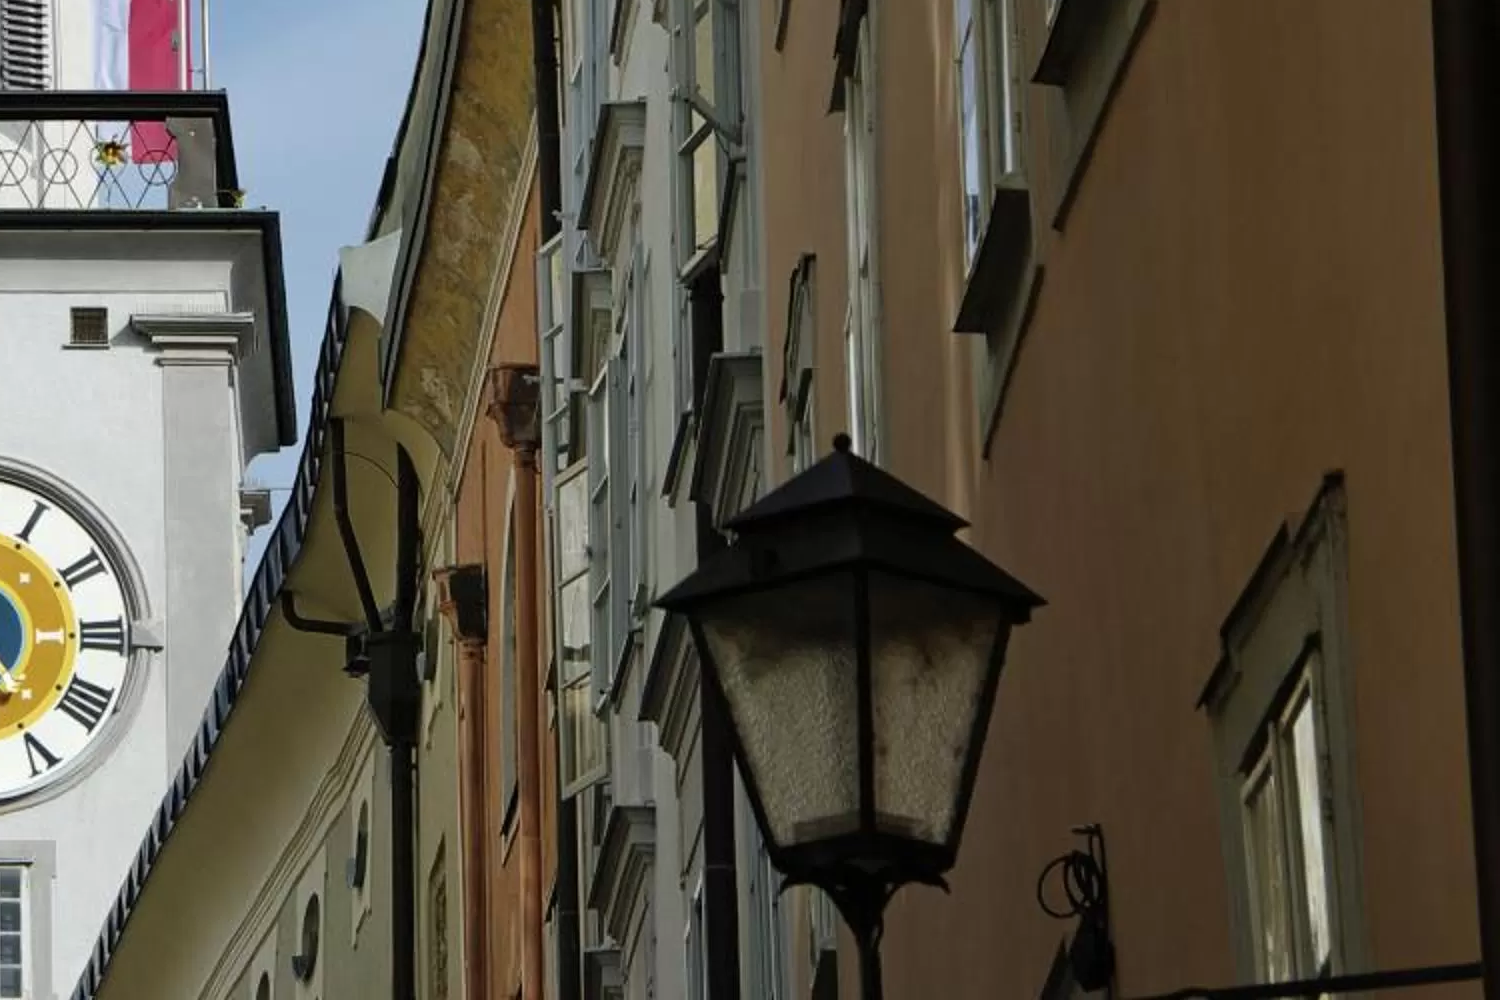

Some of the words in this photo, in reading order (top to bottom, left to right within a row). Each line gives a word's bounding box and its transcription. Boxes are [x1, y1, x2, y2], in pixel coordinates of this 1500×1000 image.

[14, 499, 51, 543] I
[57, 546, 108, 592] II
[79, 614, 125, 657] III
[53, 672, 115, 736] IIII
[23, 731, 63, 778] V
